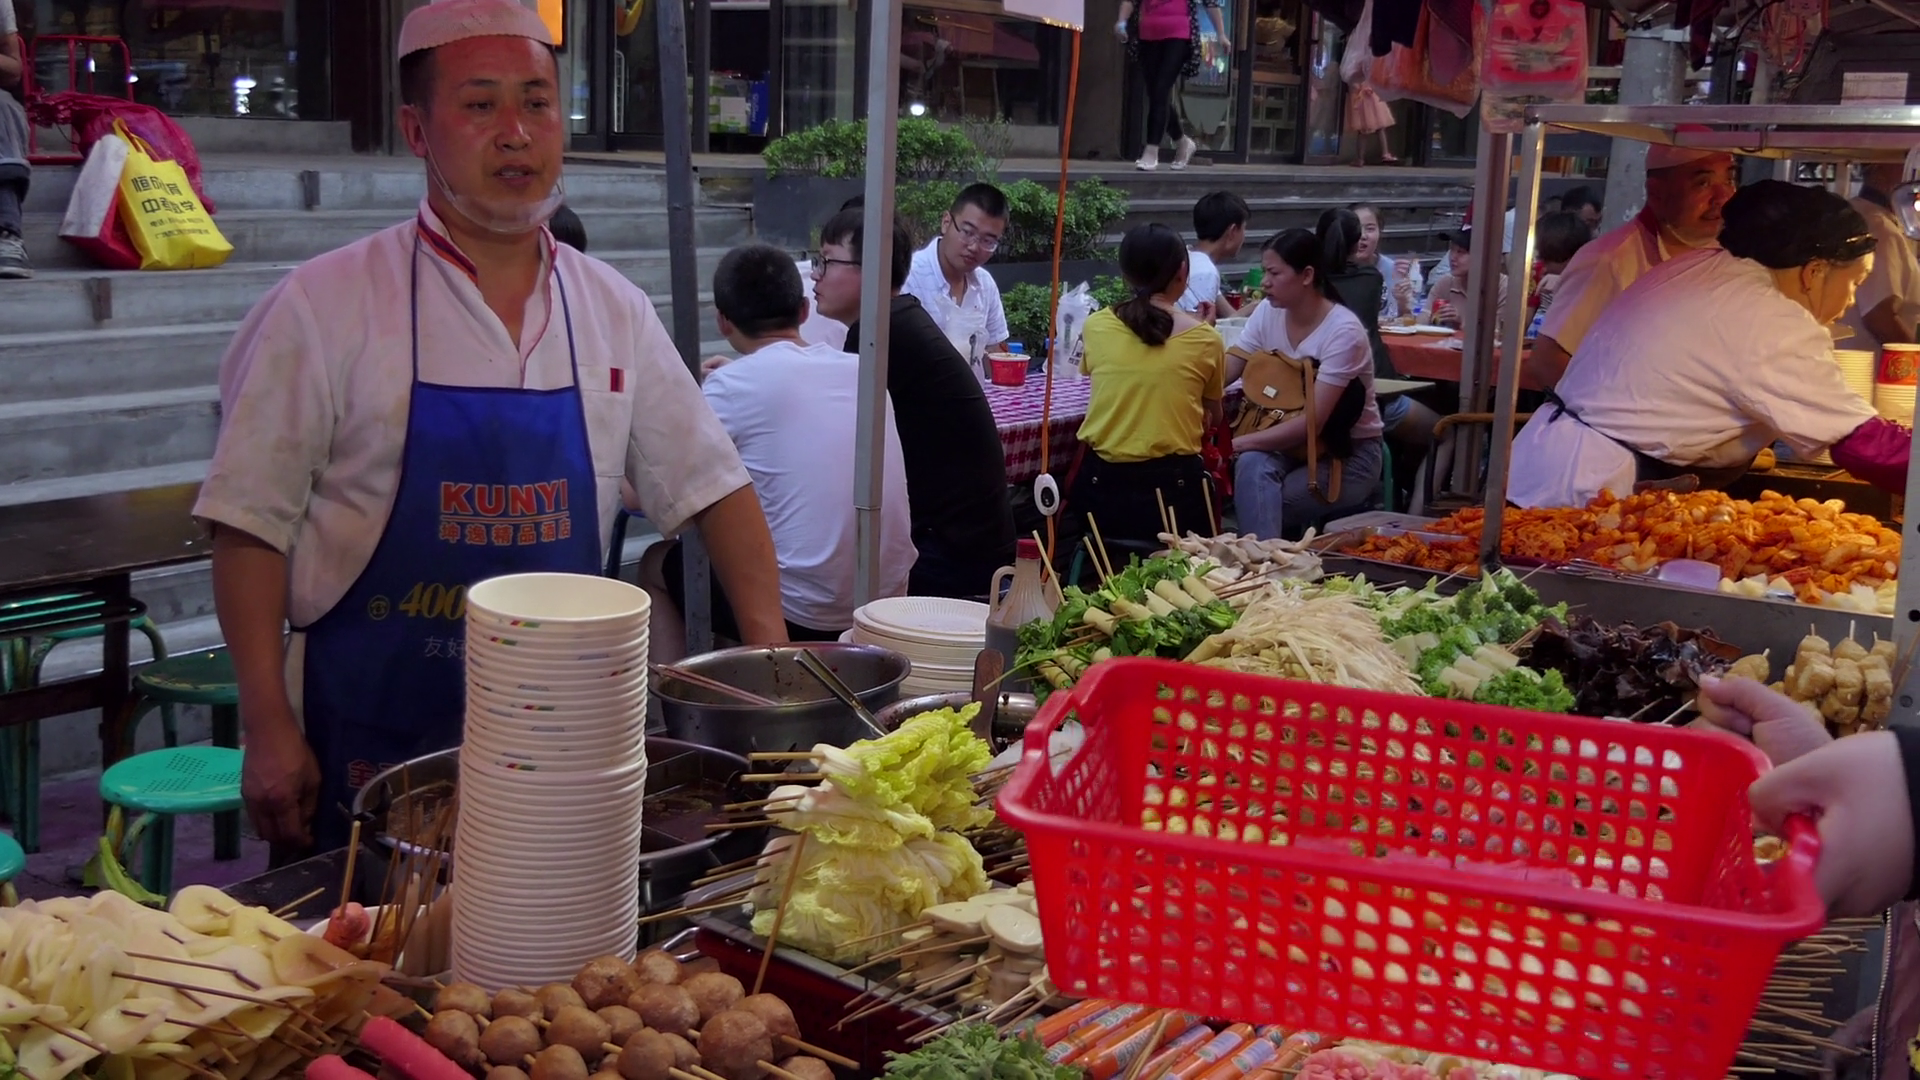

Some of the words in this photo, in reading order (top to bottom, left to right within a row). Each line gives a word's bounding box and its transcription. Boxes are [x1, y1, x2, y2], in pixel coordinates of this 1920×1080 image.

[441, 478, 568, 516] KUNYI
[440, 519, 570, 545] 坤逸精品酒店
[399, 581, 468, 620] 400
